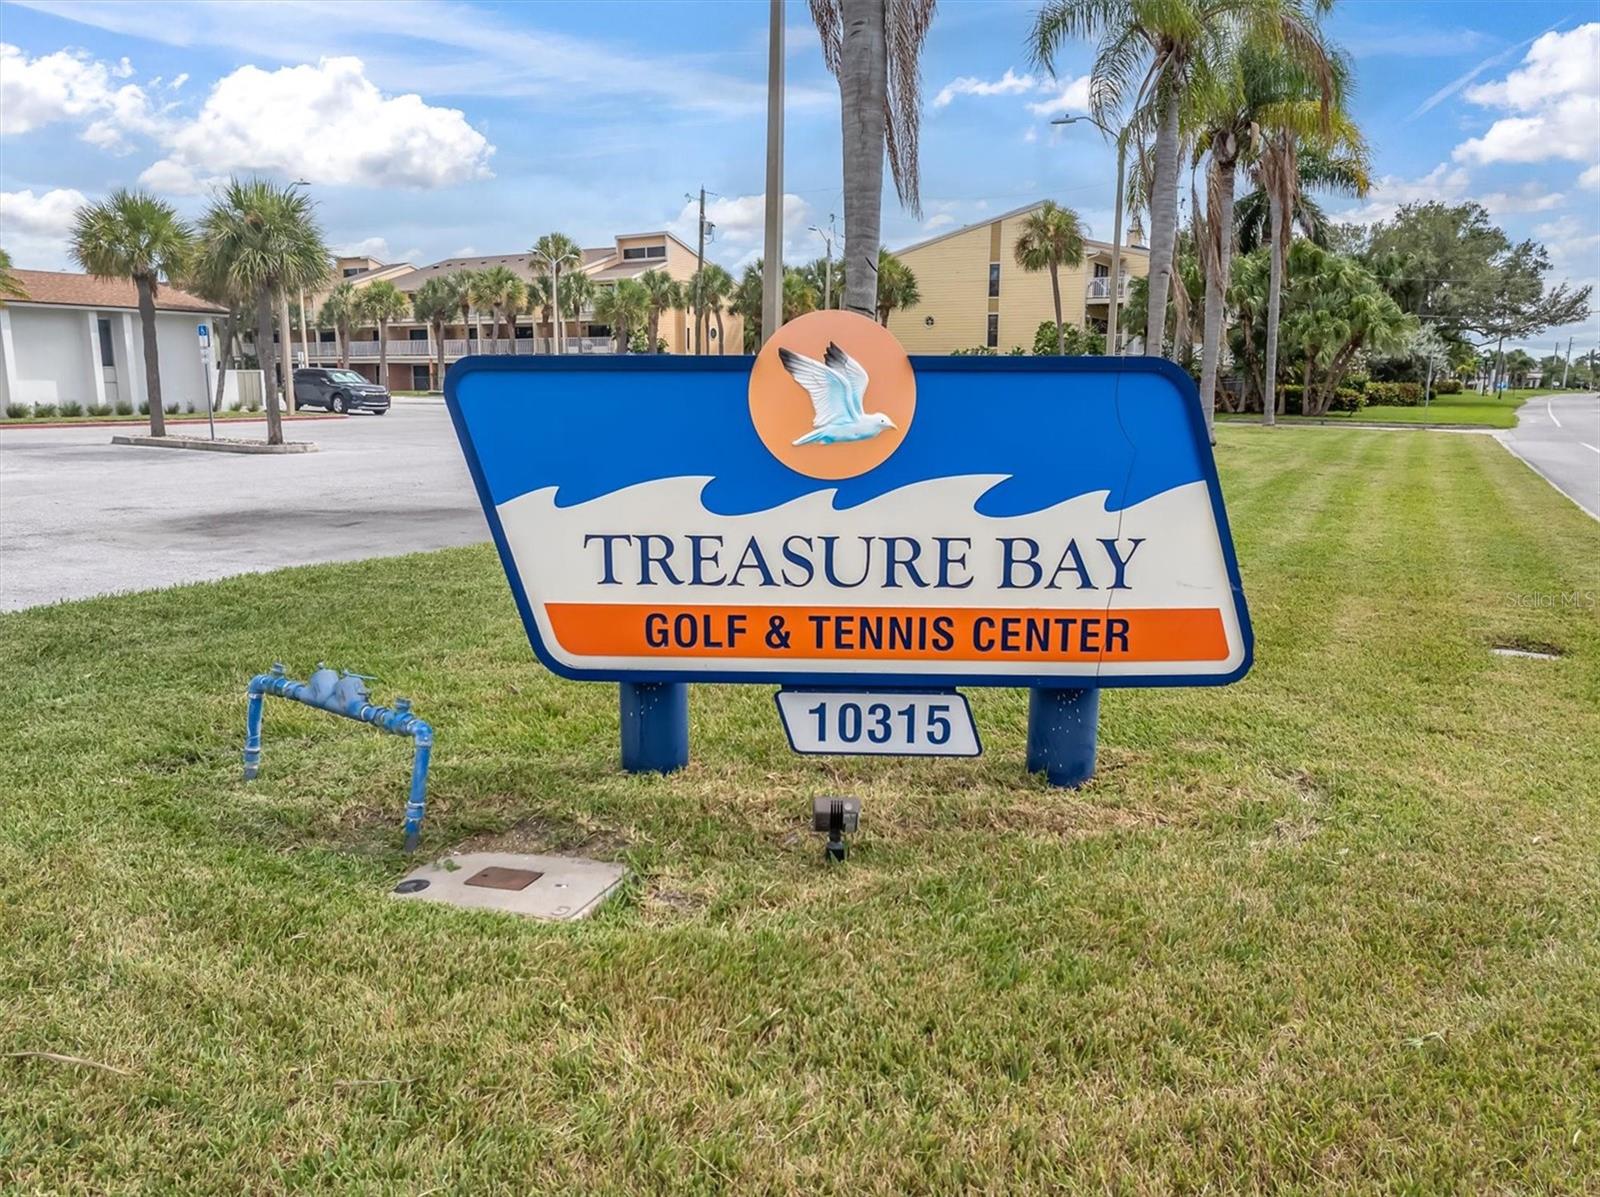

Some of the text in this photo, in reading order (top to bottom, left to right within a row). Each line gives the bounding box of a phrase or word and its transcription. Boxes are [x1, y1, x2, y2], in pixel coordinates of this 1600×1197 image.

[584, 534, 1147, 591] TREASURE BAY
[645, 613, 1130, 653] GOLF & TENNIS CENTER
[808, 702, 951, 745] 10315
